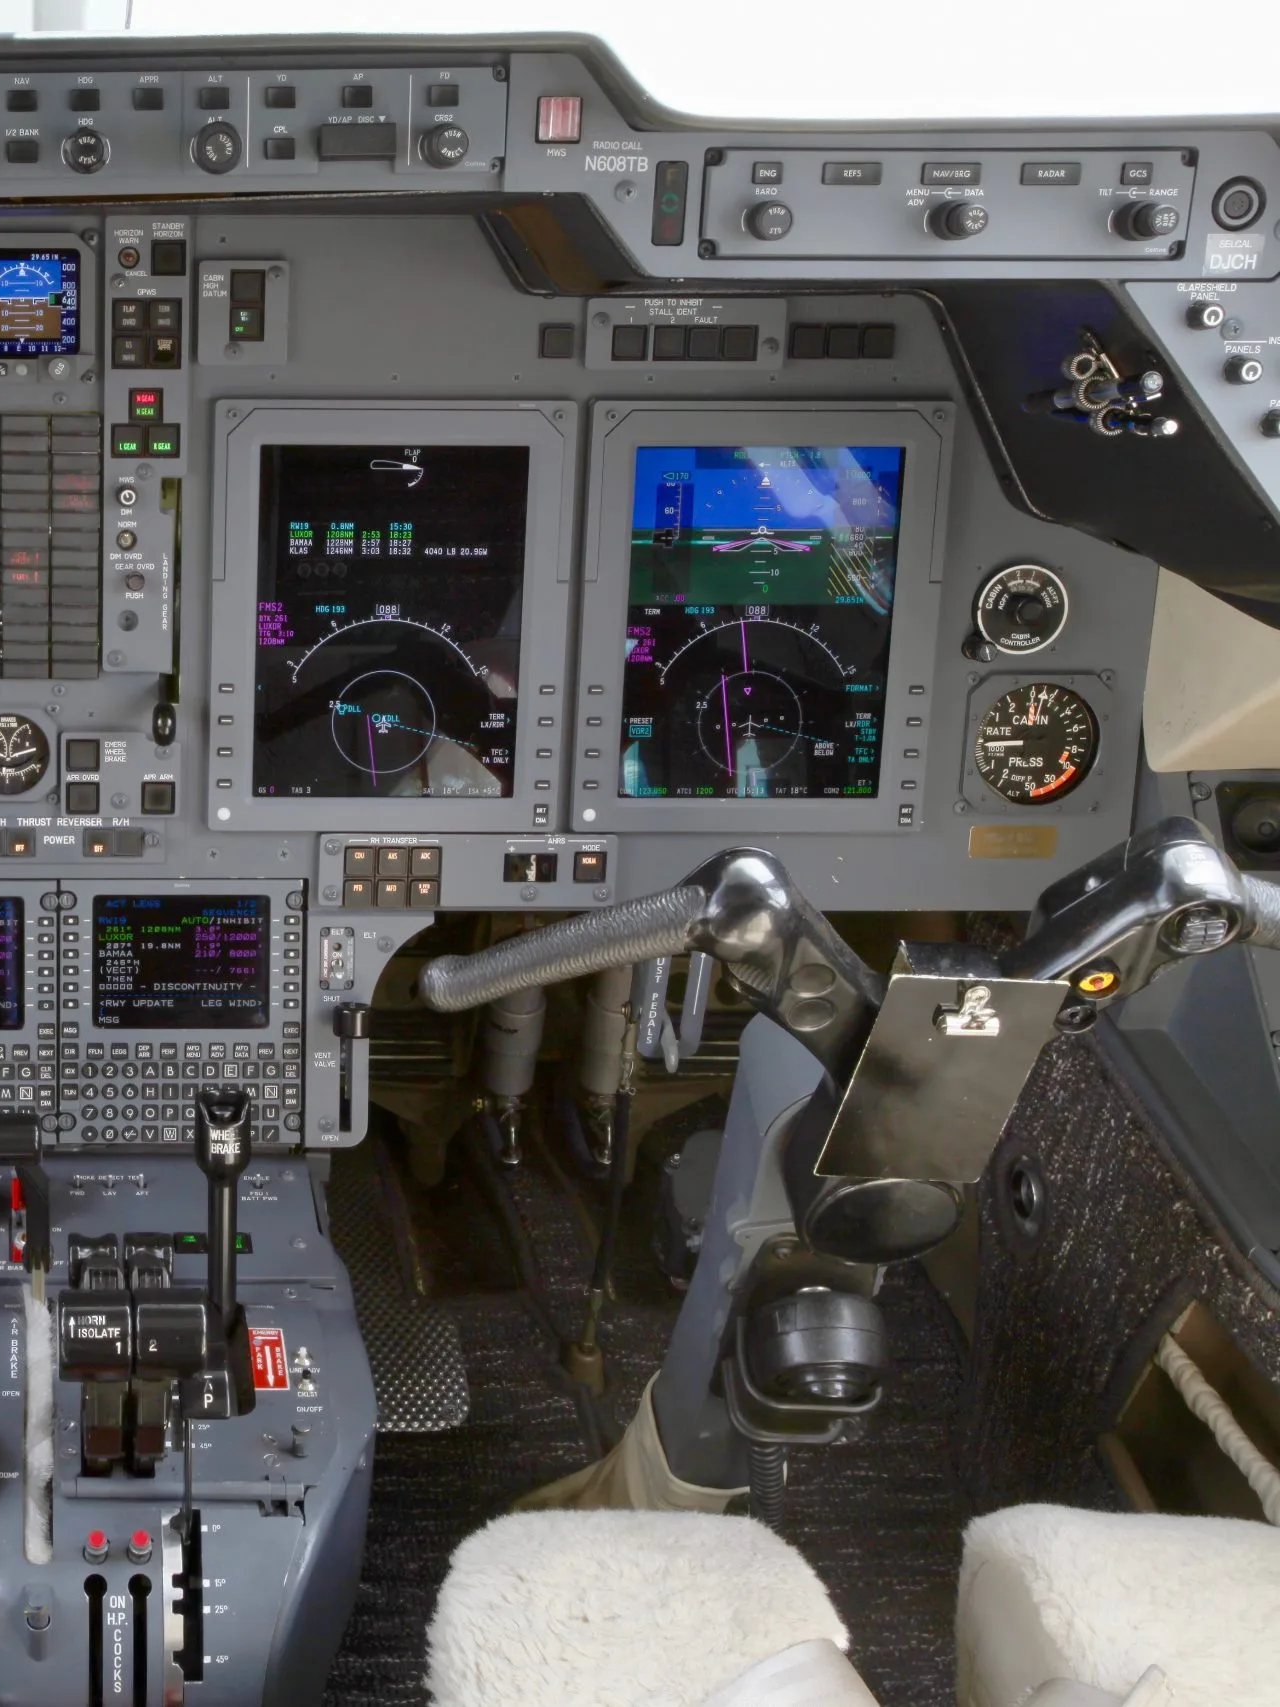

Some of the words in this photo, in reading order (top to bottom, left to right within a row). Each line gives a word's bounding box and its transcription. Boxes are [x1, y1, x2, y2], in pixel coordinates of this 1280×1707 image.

[208, 74, 222, 83] ALT
[440, 72, 450, 80] FD
[207, 116, 223, 124] ALT
[328, 116, 352, 124] YD/AP
[593, 141, 620, 150] RADIO
[621, 141, 642, 150] CALL
[547, 148, 566, 157] MWS
[585, 156, 648, 172] N608TB
[759, 169, 777, 177] ENG
[933, 170, 971, 178] NAV/BRG
[1038, 170, 1065, 178] RADAR
[1129, 169, 1147, 178] GCS
[755, 187, 778, 196] BARO
[1209, 254, 1257, 270] DJCH
[1176, 283, 1237, 292] GLARESHIELD
[1190, 292, 1220, 301] PANEL
[1225, 345, 1261, 354] PANELS
[259, 602, 282, 612] FMS2
[379, 605, 396, 614] 088
[748, 606, 766, 615] 088
[628, 627, 650, 636] FMS2
[986, 727, 1012, 736] RATE
[1008, 757, 1043, 767] PRESS
[17, 818, 52, 826] THRUST
[57, 818, 102, 826] REVERSER
[112, 818, 130, 826] R/H
[44, 836, 75, 844] POWER
[211, 1142, 241, 1154] BRAKE
[204, 1394, 213, 1408] P
[110, 1595, 126, 1608] ON
[107, 1612, 128, 1625] H.P.
[114, 1628, 122, 1693] COCKS
